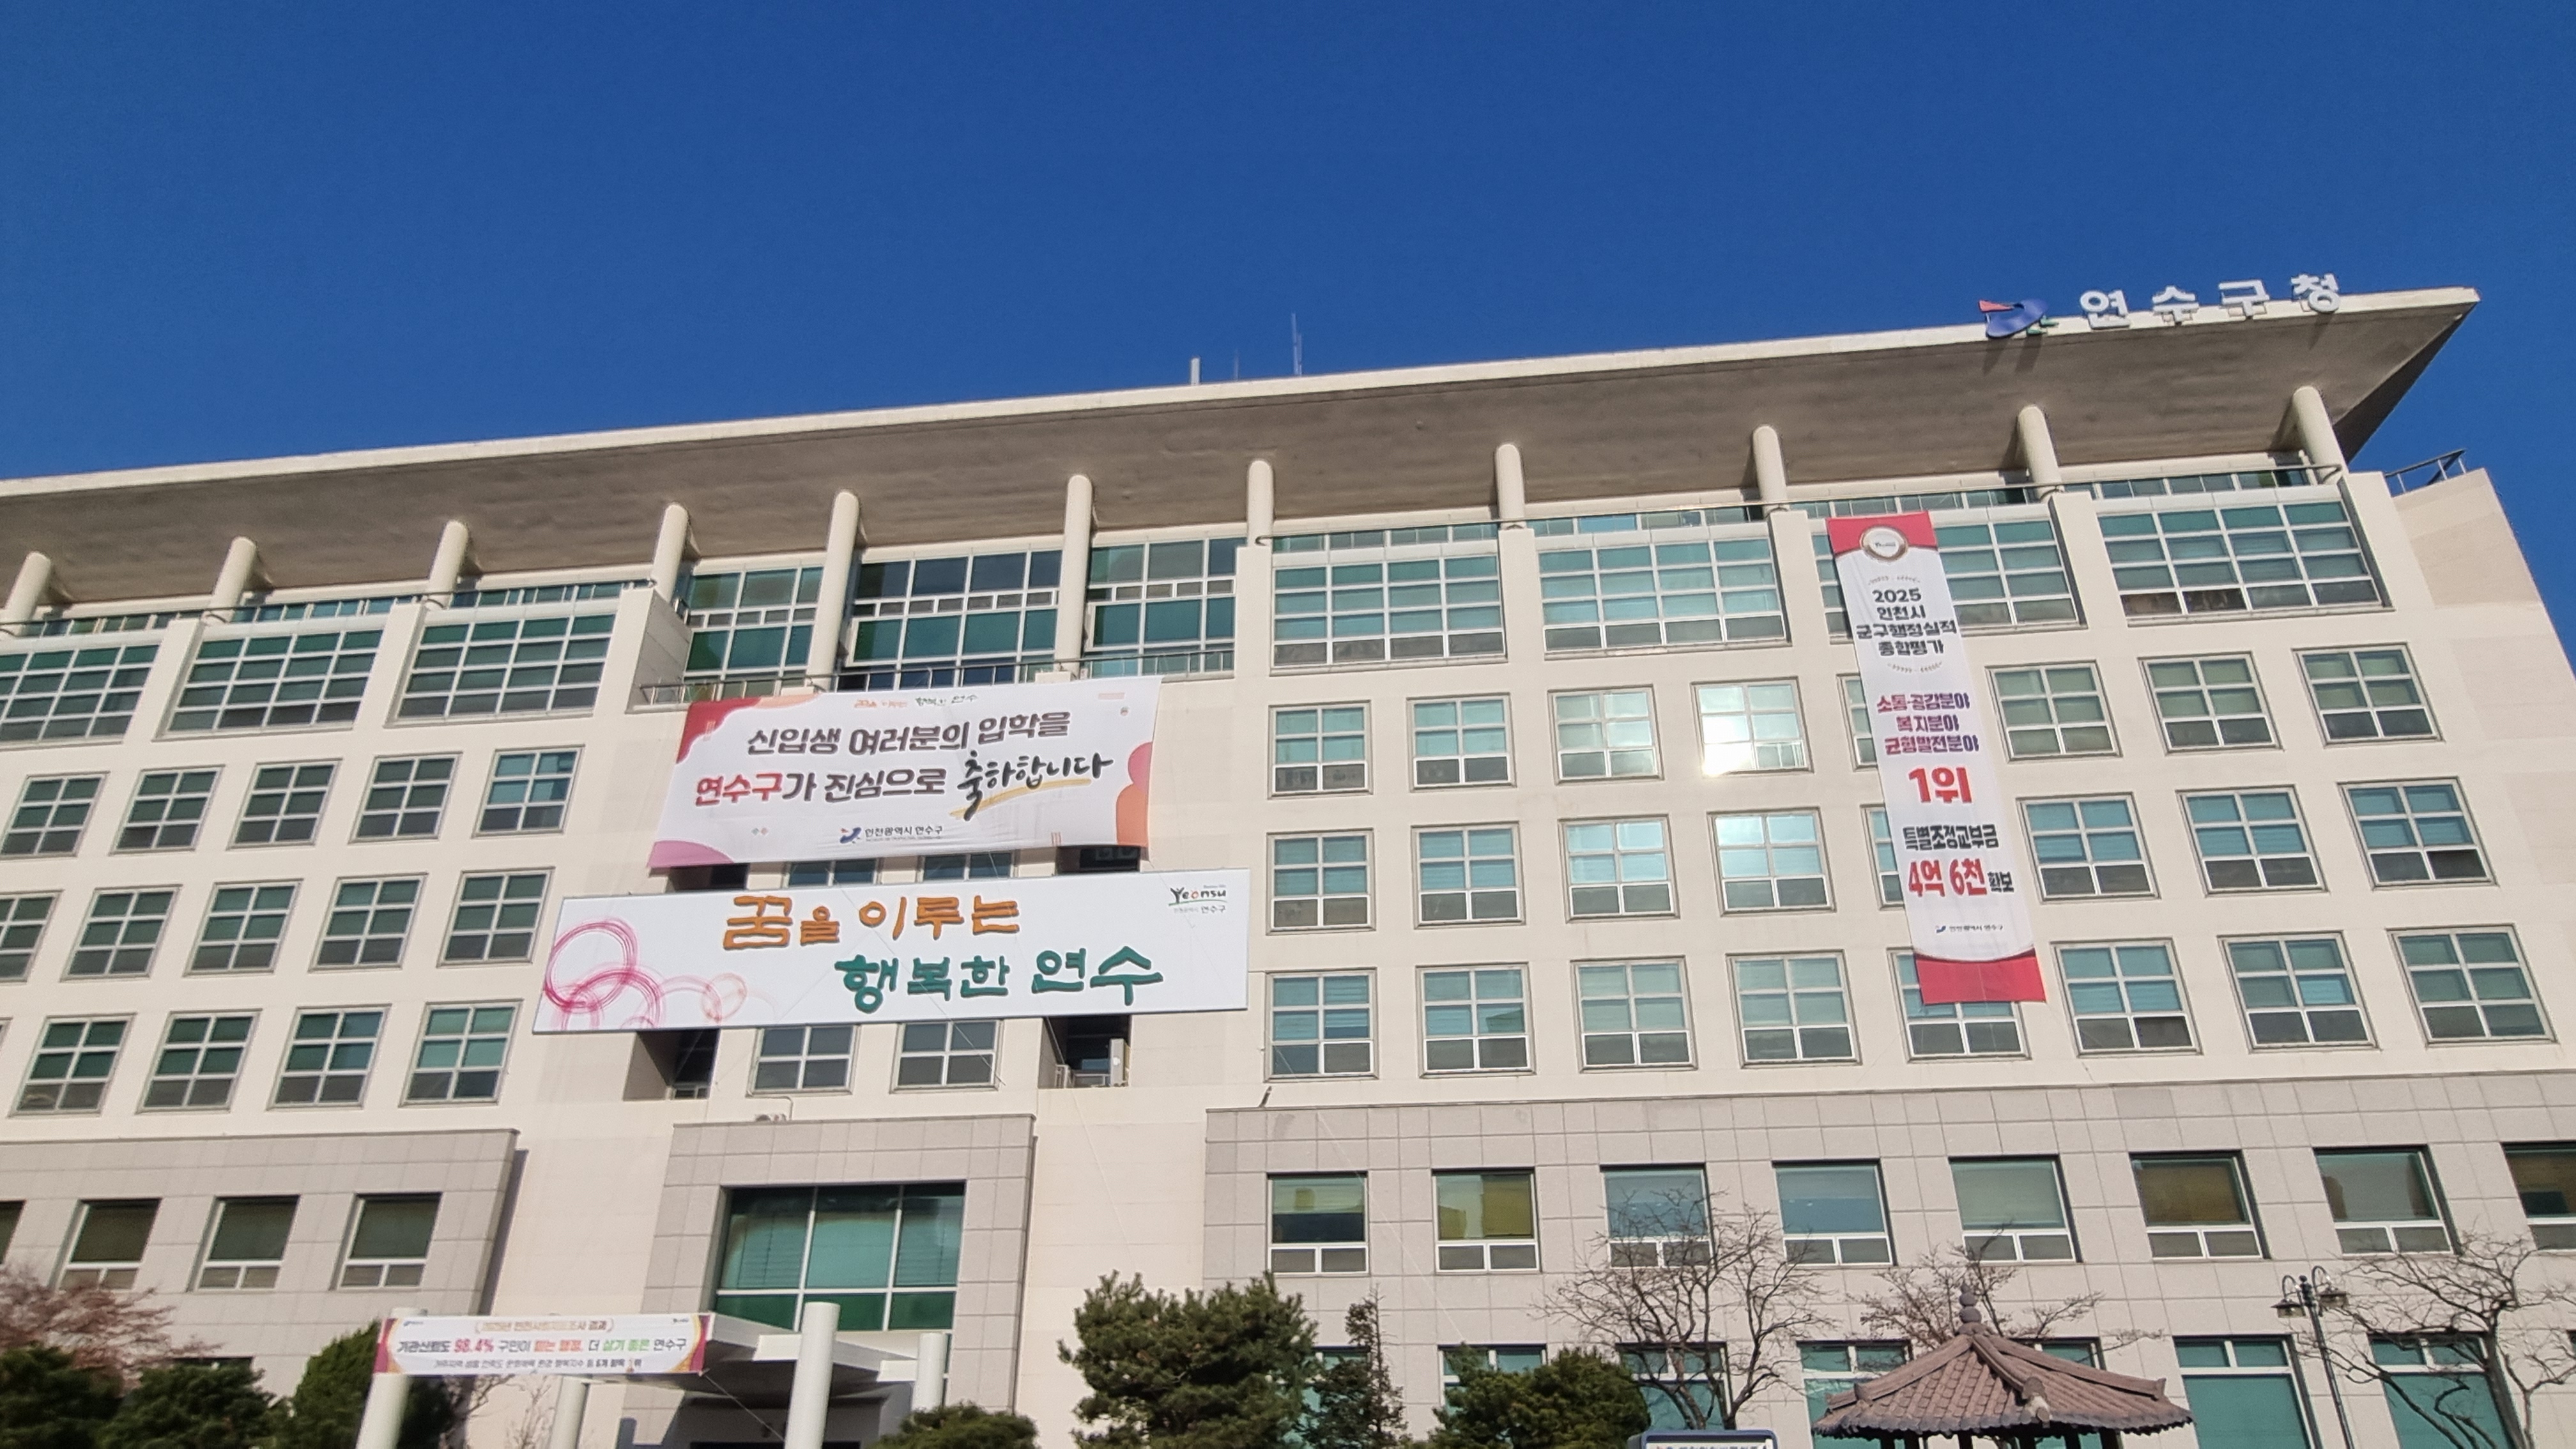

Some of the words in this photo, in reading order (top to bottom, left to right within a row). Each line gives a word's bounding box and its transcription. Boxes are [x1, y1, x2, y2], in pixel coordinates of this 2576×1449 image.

[2080, 273, 2341, 329] 연수구청
[1871, 587, 1922, 603] 2025
[1876, 604, 1926, 620] 인천시
[1878, 639, 1944, 656] 종합평가
[747, 728, 842, 755] 신입생
[848, 721, 970, 756] 여러분의
[977, 711, 1071, 745] 입학을
[1896, 714, 1959, 732] 복지분야
[1885, 735, 1979, 755] 균형발전분야
[695, 771, 818, 808] 연수구가
[824, 768, 947, 804] 진심으로
[956, 749, 1115, 822] 축하합니다
[1908, 767, 1973, 804] 1위
[865, 826, 912, 837] 인천광역시
[915, 824, 943, 835] 연수구
[1903, 824, 1999, 850] 특별조정교부금
[1908, 859, 1946, 898] 4억
[1949, 857, 1988, 896] 6천
[1988, 871, 2014, 893] 확보
[1170, 887, 1226, 904] Yeonsu
[723, 894, 841, 951] 꿈을
[858, 893, 1020, 940] 이루는
[833, 953, 1009, 1014] 행복한
[1031, 946, 1164, 1006] 연수
[653, 1338, 687, 1351] 연수구
